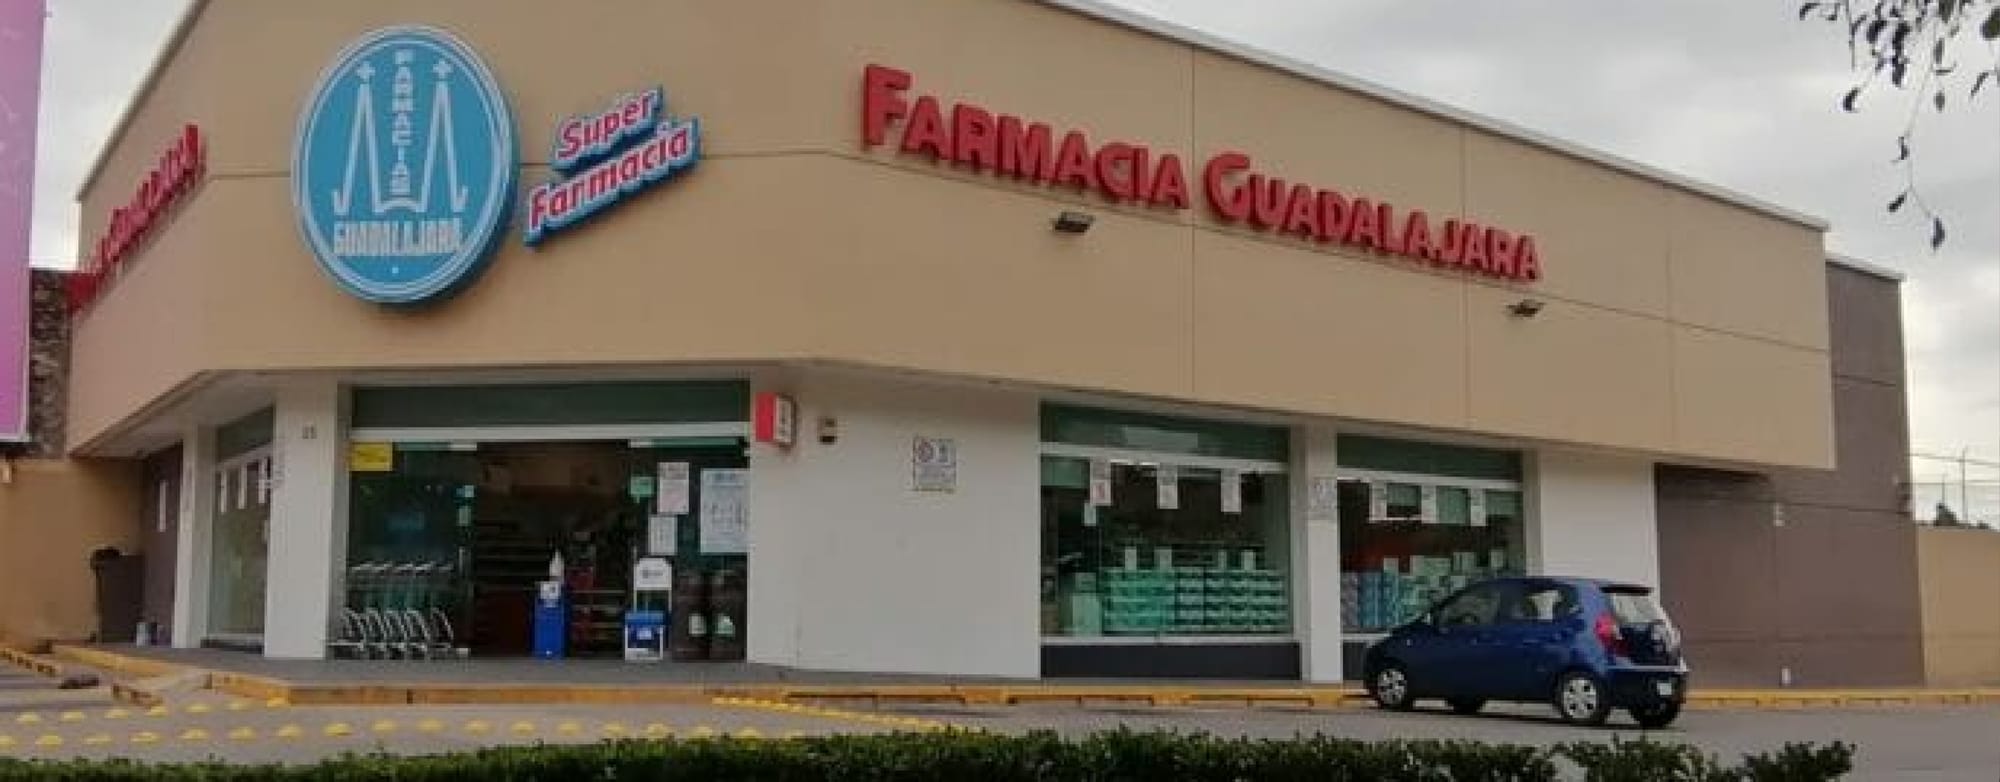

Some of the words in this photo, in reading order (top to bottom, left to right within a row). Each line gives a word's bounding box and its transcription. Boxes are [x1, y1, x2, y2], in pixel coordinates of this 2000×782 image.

[390, 51, 415, 196] FARMACIAS
[529, 121, 695, 231] Farmacia
[555, 90, 660, 161] Super
[862, 64, 1190, 207] FARMACIA
[1203, 152, 1543, 283] GUADALAJARA
[334, 217, 462, 256] GUADALAJARA
